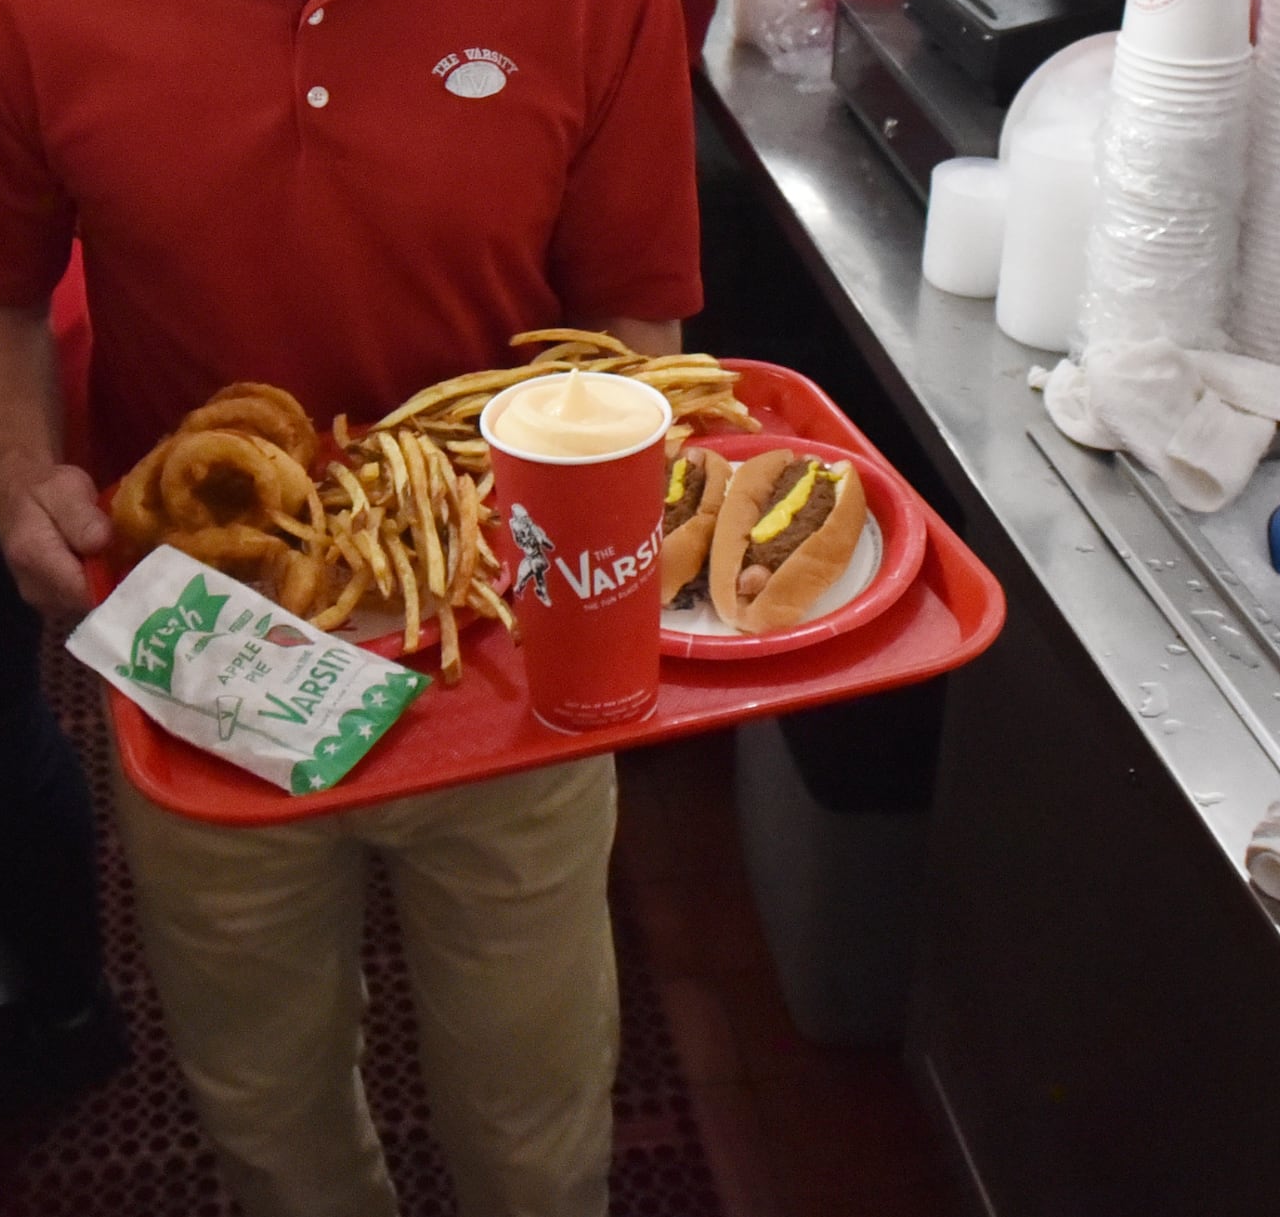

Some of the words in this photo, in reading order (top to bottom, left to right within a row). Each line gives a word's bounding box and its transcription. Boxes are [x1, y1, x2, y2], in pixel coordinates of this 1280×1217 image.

[431, 53, 461, 77] THE
[463, 47, 519, 75] VARSITY
[593, 545, 617, 562] THE
[216, 641, 262, 686] APPLE
[244, 660, 273, 684] PIE
